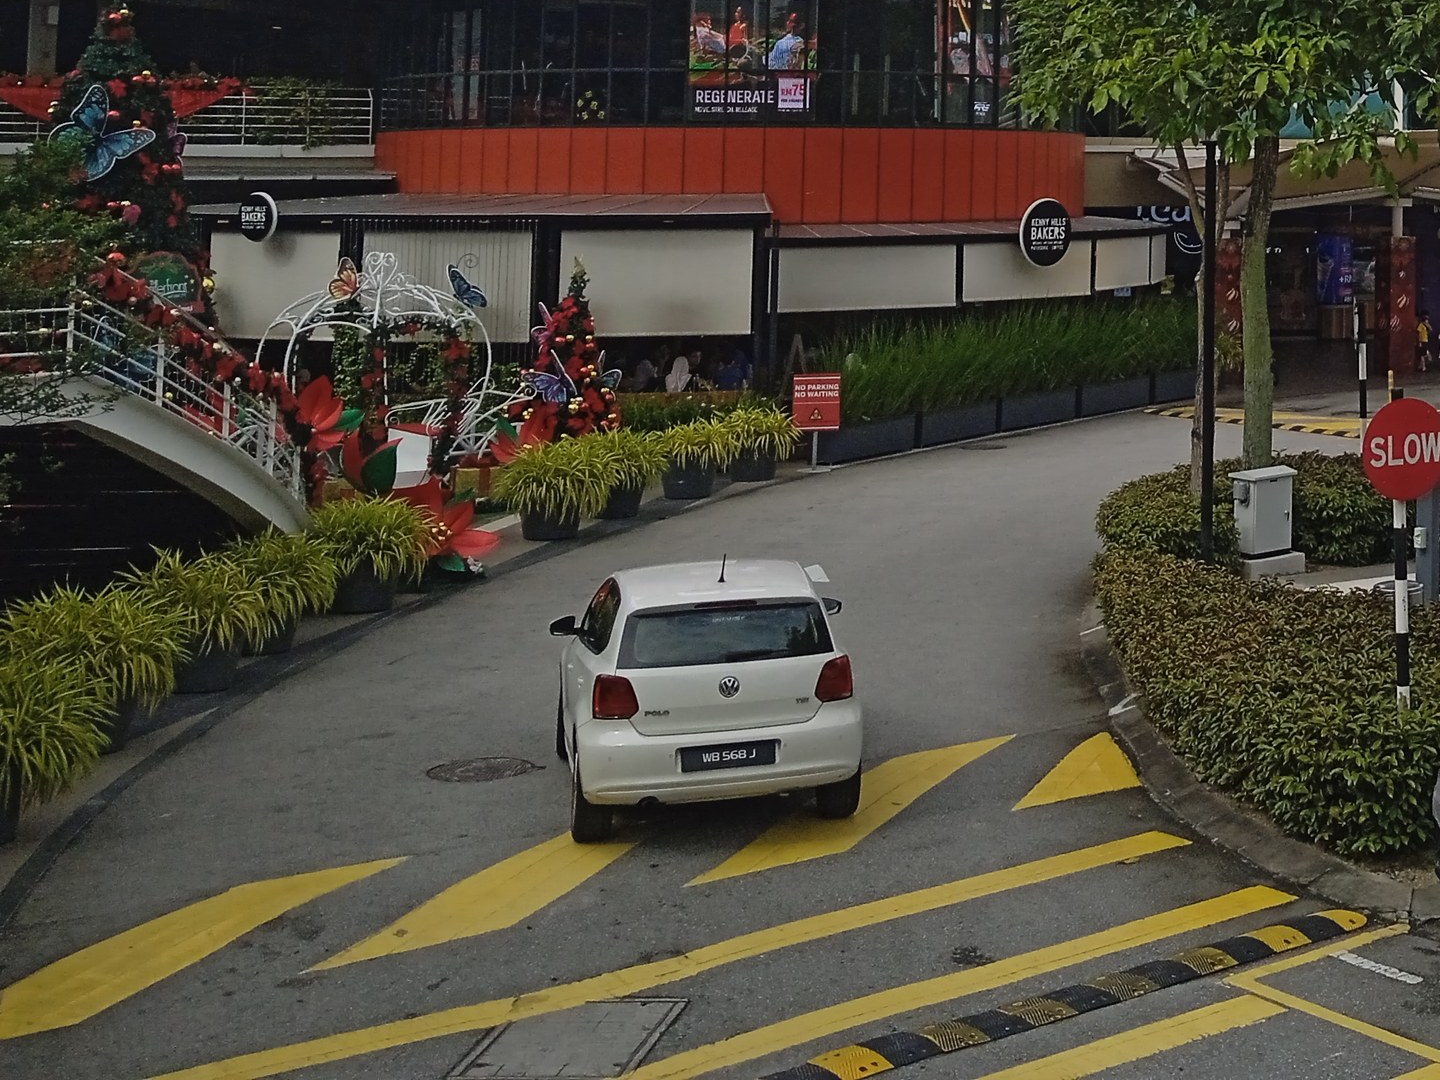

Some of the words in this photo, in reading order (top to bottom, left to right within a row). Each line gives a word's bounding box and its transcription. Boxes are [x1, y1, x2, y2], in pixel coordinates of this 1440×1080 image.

[696, 90, 775, 104] REGENERATE
[1031, 218, 1050, 227] KENNY
[1030, 226, 1066, 241] BAKERS
[807, 383, 839, 391] PARKING
[807, 390, 839, 398] WAITING
[644, 709, 671, 717] POLO
[702, 752, 720, 763] WB
[722, 749, 747, 761] 568
[749, 748, 756, 758] J
